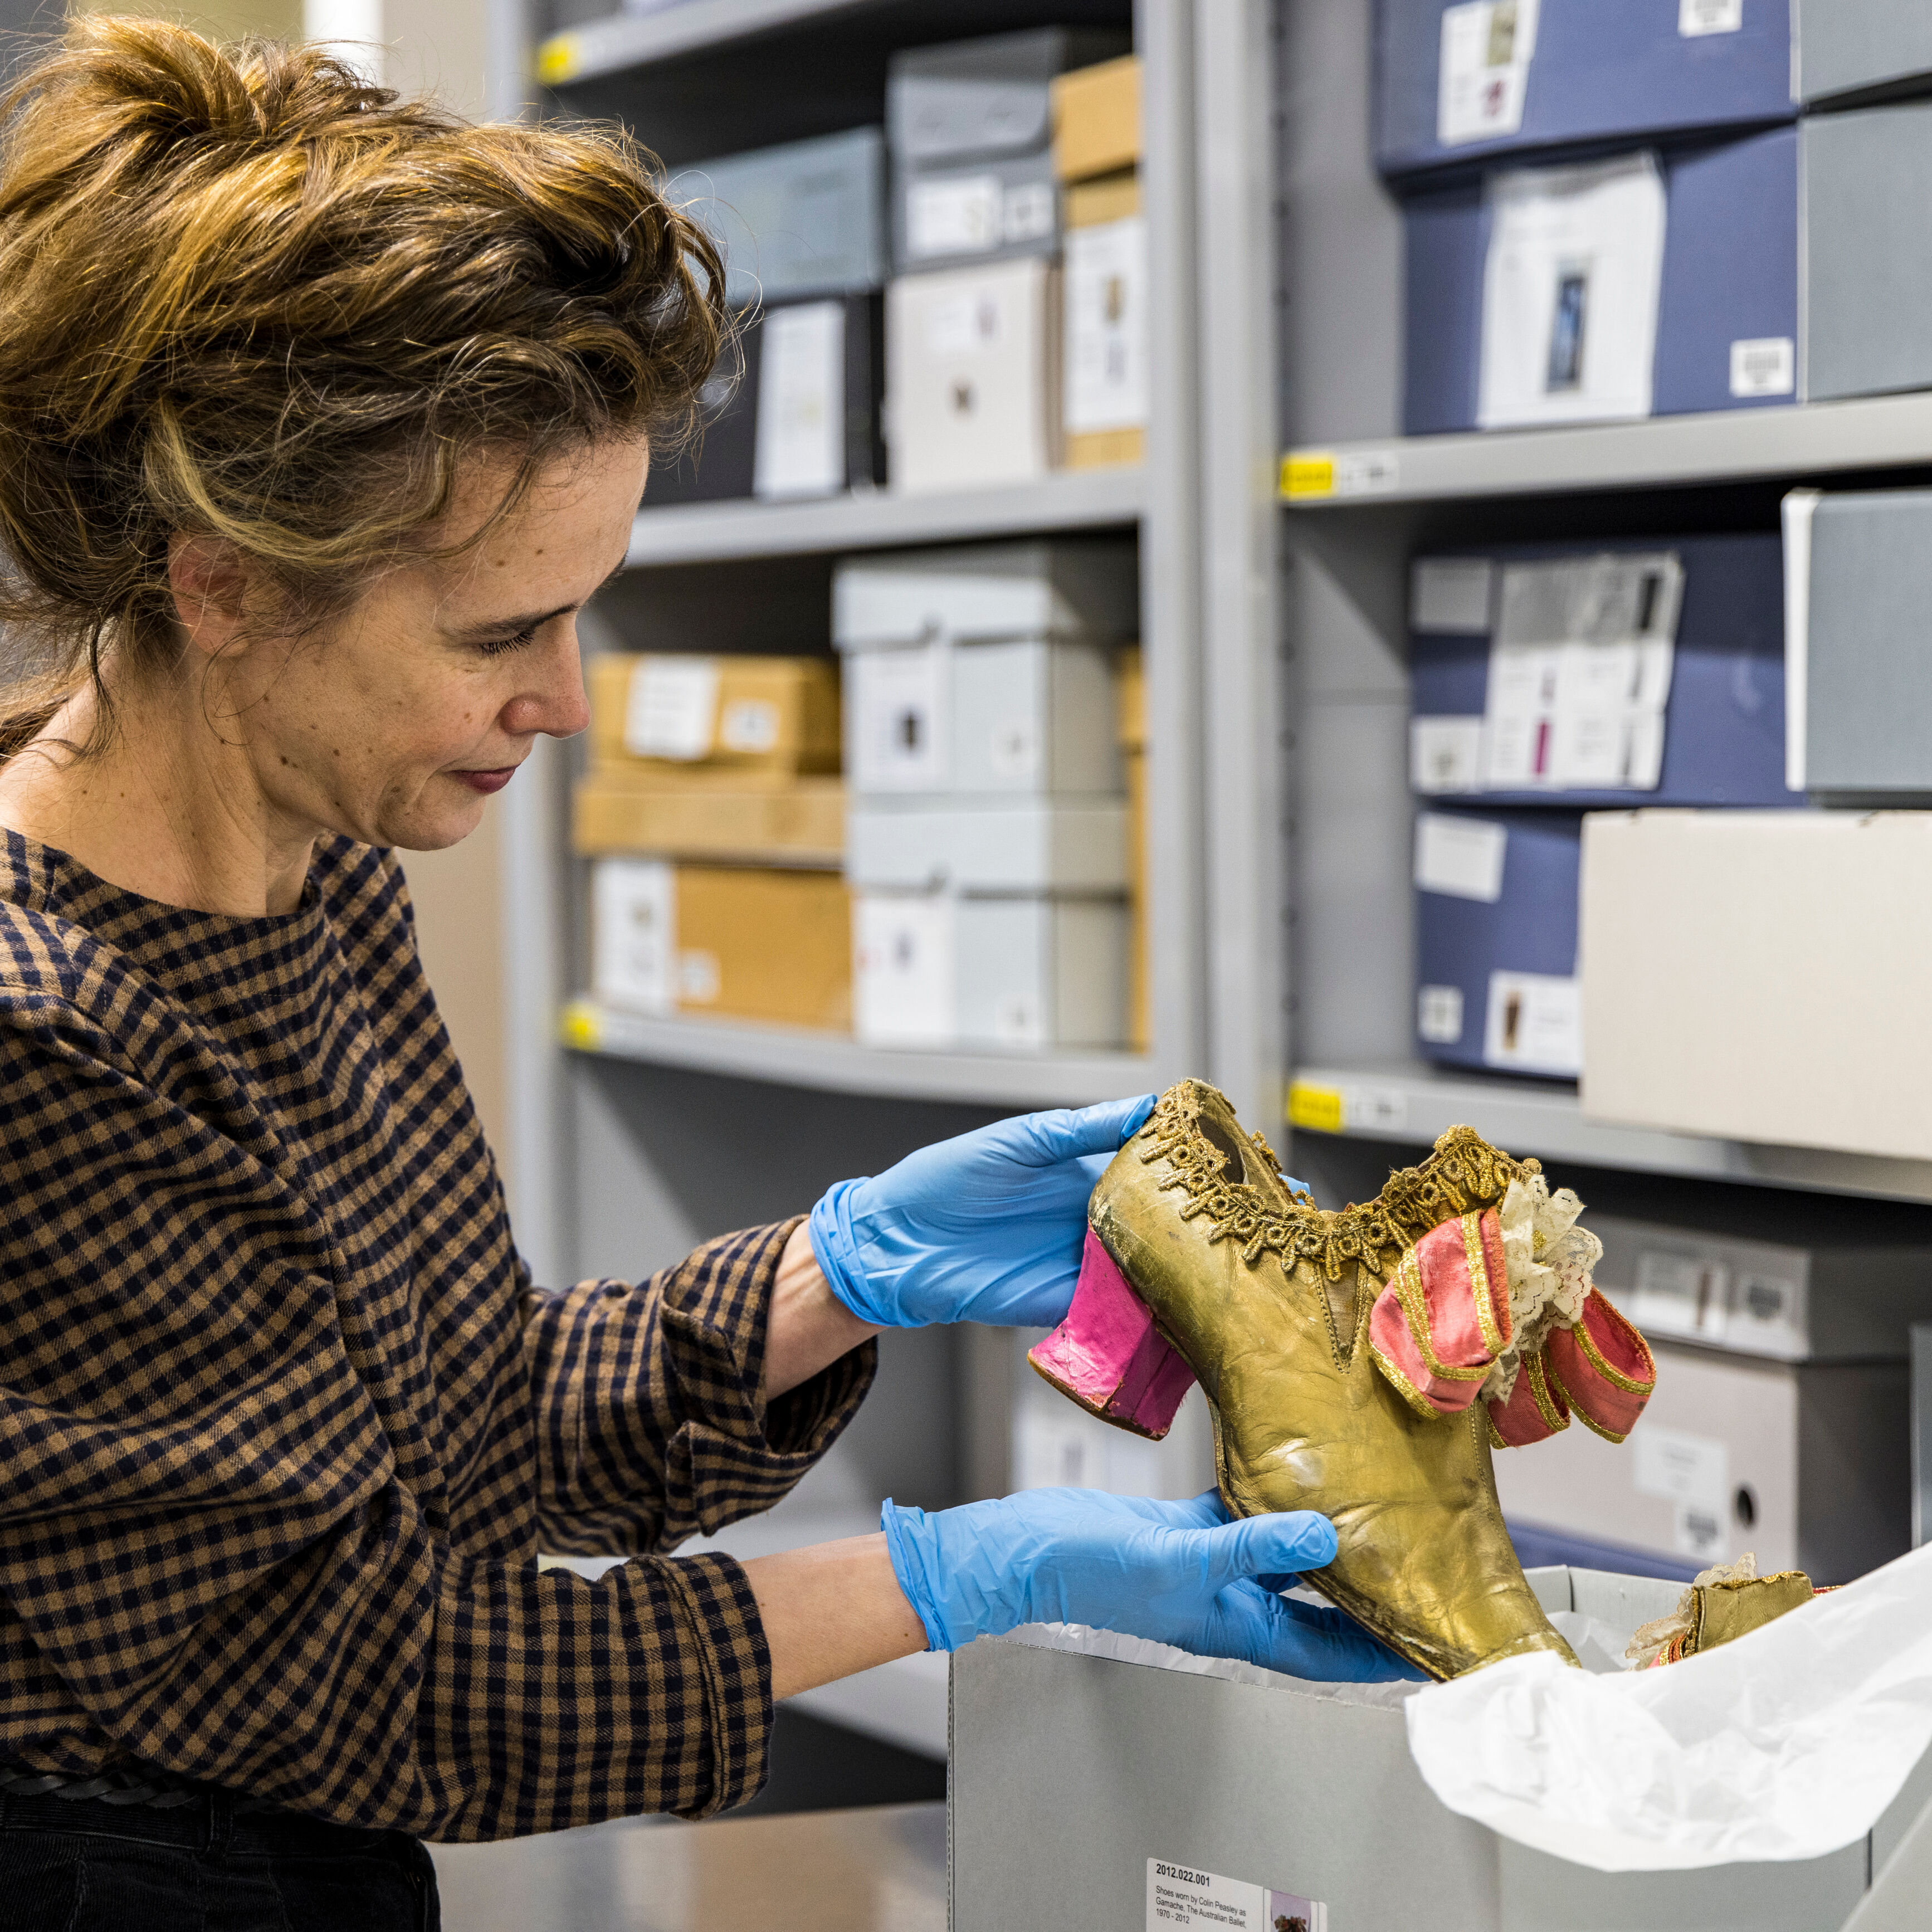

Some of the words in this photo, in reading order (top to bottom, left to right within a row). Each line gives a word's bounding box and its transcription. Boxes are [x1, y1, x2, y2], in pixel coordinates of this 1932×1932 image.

[1156, 1863, 1209, 1887] 2012.022.001
[1156, 1885, 1174, 1897] Shoes
[1175, 1892, 1189, 1901] worn
[1191, 1895, 1198, 1905] by
[1199, 1896, 1213, 1908] Colin
[1215, 1901, 1238, 1916] Peasley
[1156, 1896, 1185, 1913] Gamache,
[1187, 1905, 1198, 1915] The
[1199, 1908, 1227, 1923] Australian
[1229, 1916, 1247, 1929] Ballet,
[1157, 1908, 1170, 1919] 1970
[1175, 1913, 1189, 1924] 2012
